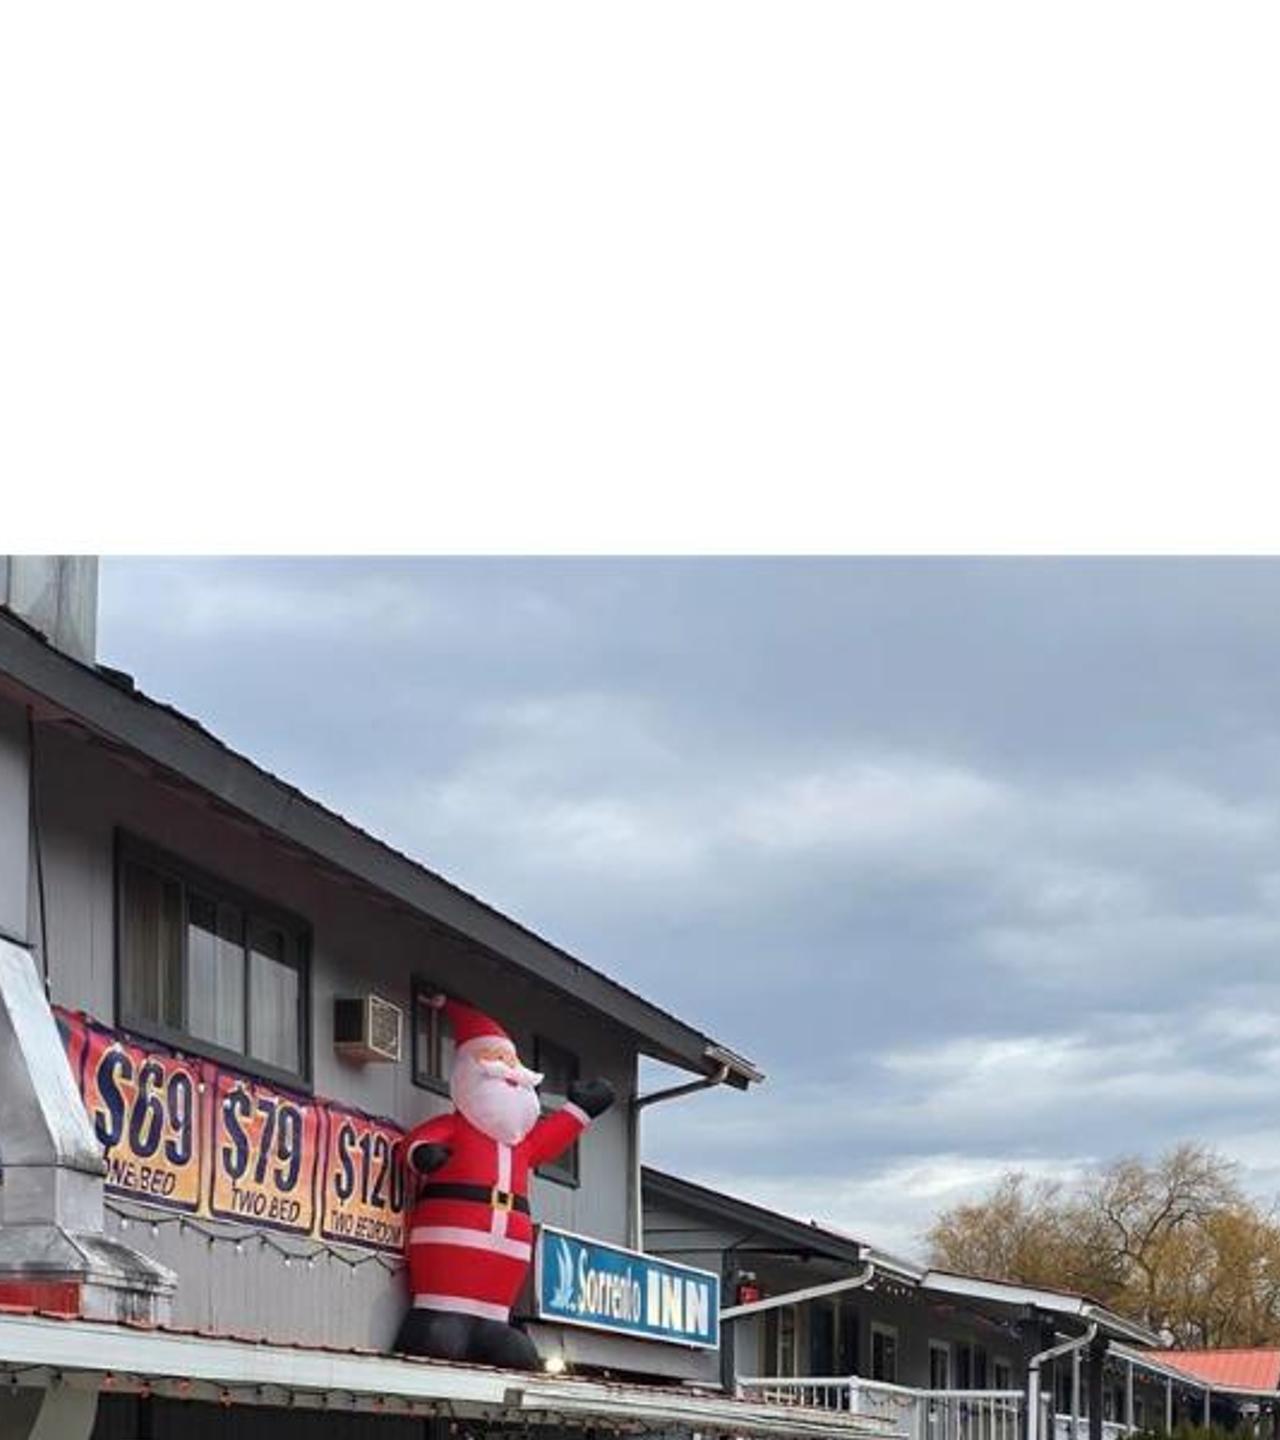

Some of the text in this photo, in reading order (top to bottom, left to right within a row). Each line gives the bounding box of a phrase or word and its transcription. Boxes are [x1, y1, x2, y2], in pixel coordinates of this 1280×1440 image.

[94, 1041, 195, 1167] $69
[222, 1079, 303, 1193] $79
[140, 1165, 177, 1196] BED
[231, 1187, 301, 1223] TWO BED
[331, 1209, 354, 1233] TWO
[577, 1247, 709, 1337] Sorrento INN
